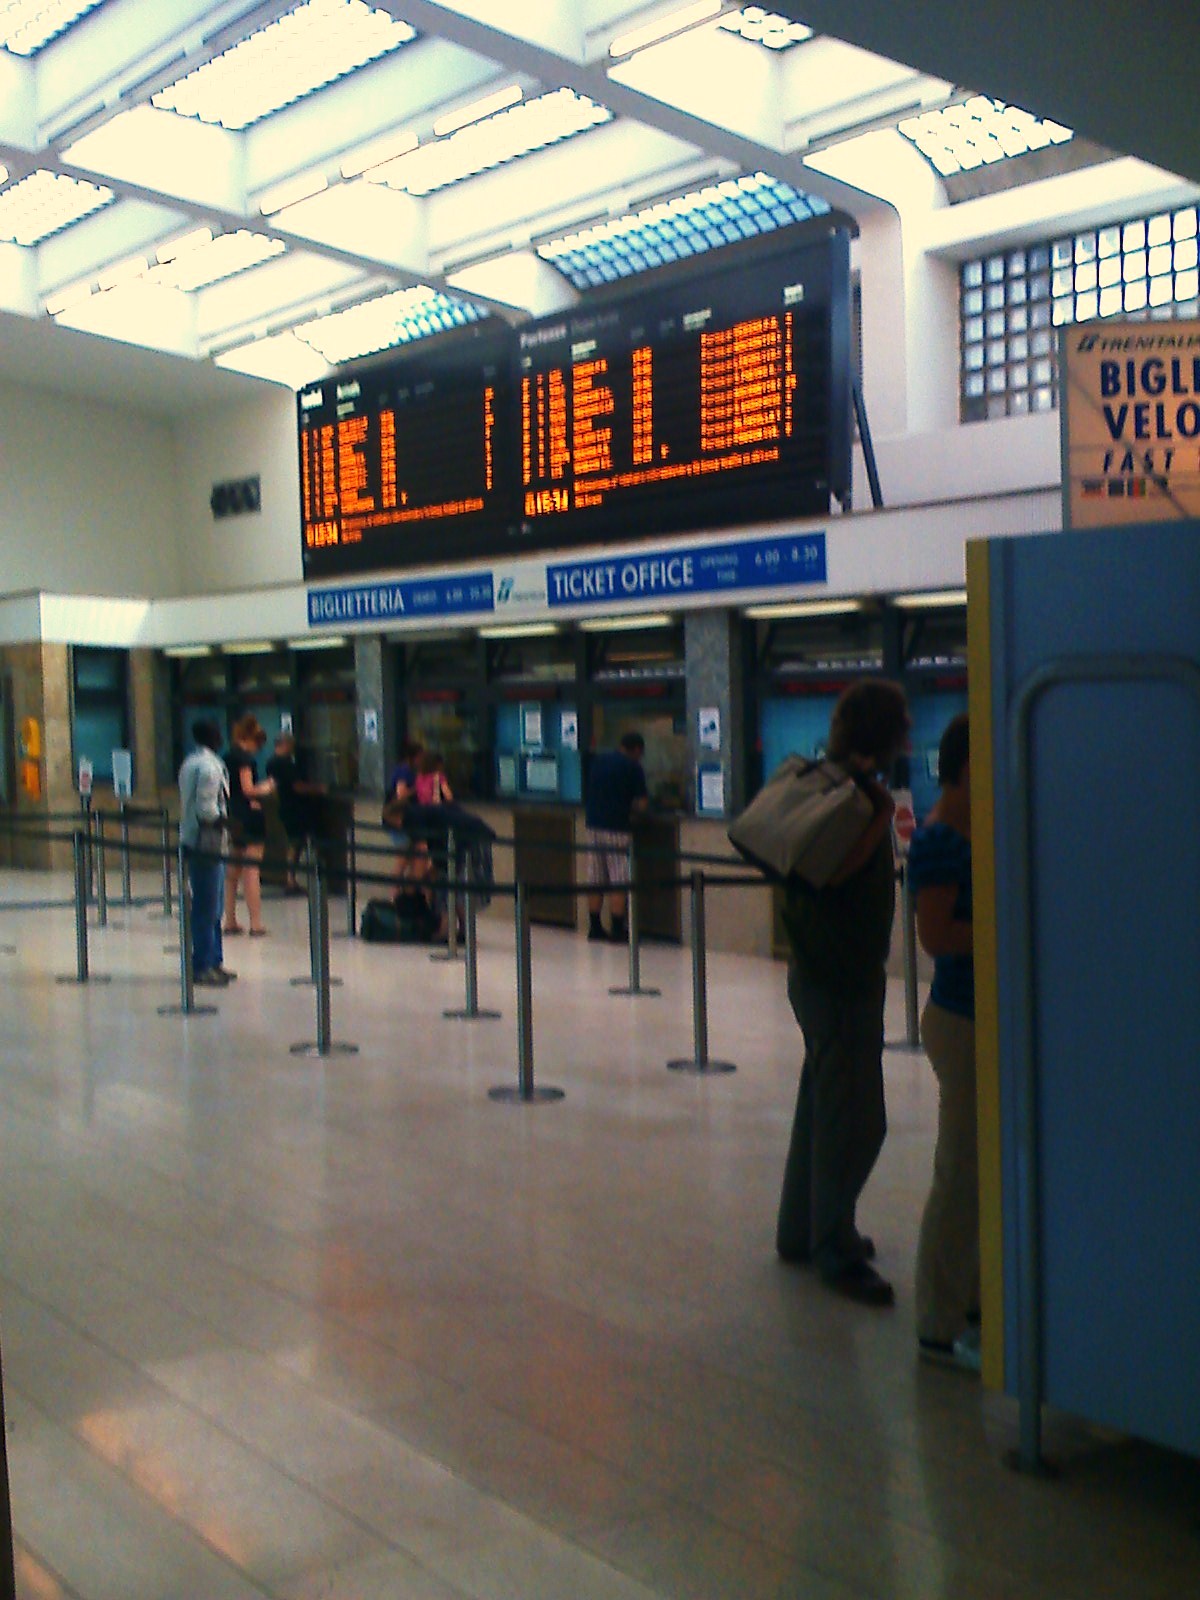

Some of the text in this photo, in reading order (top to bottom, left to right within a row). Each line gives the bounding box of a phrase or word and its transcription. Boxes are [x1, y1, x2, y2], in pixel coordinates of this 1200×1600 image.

[553, 556, 695, 598] TICKET OFFICE
[311, 588, 405, 619] BIGLIETTERIA
